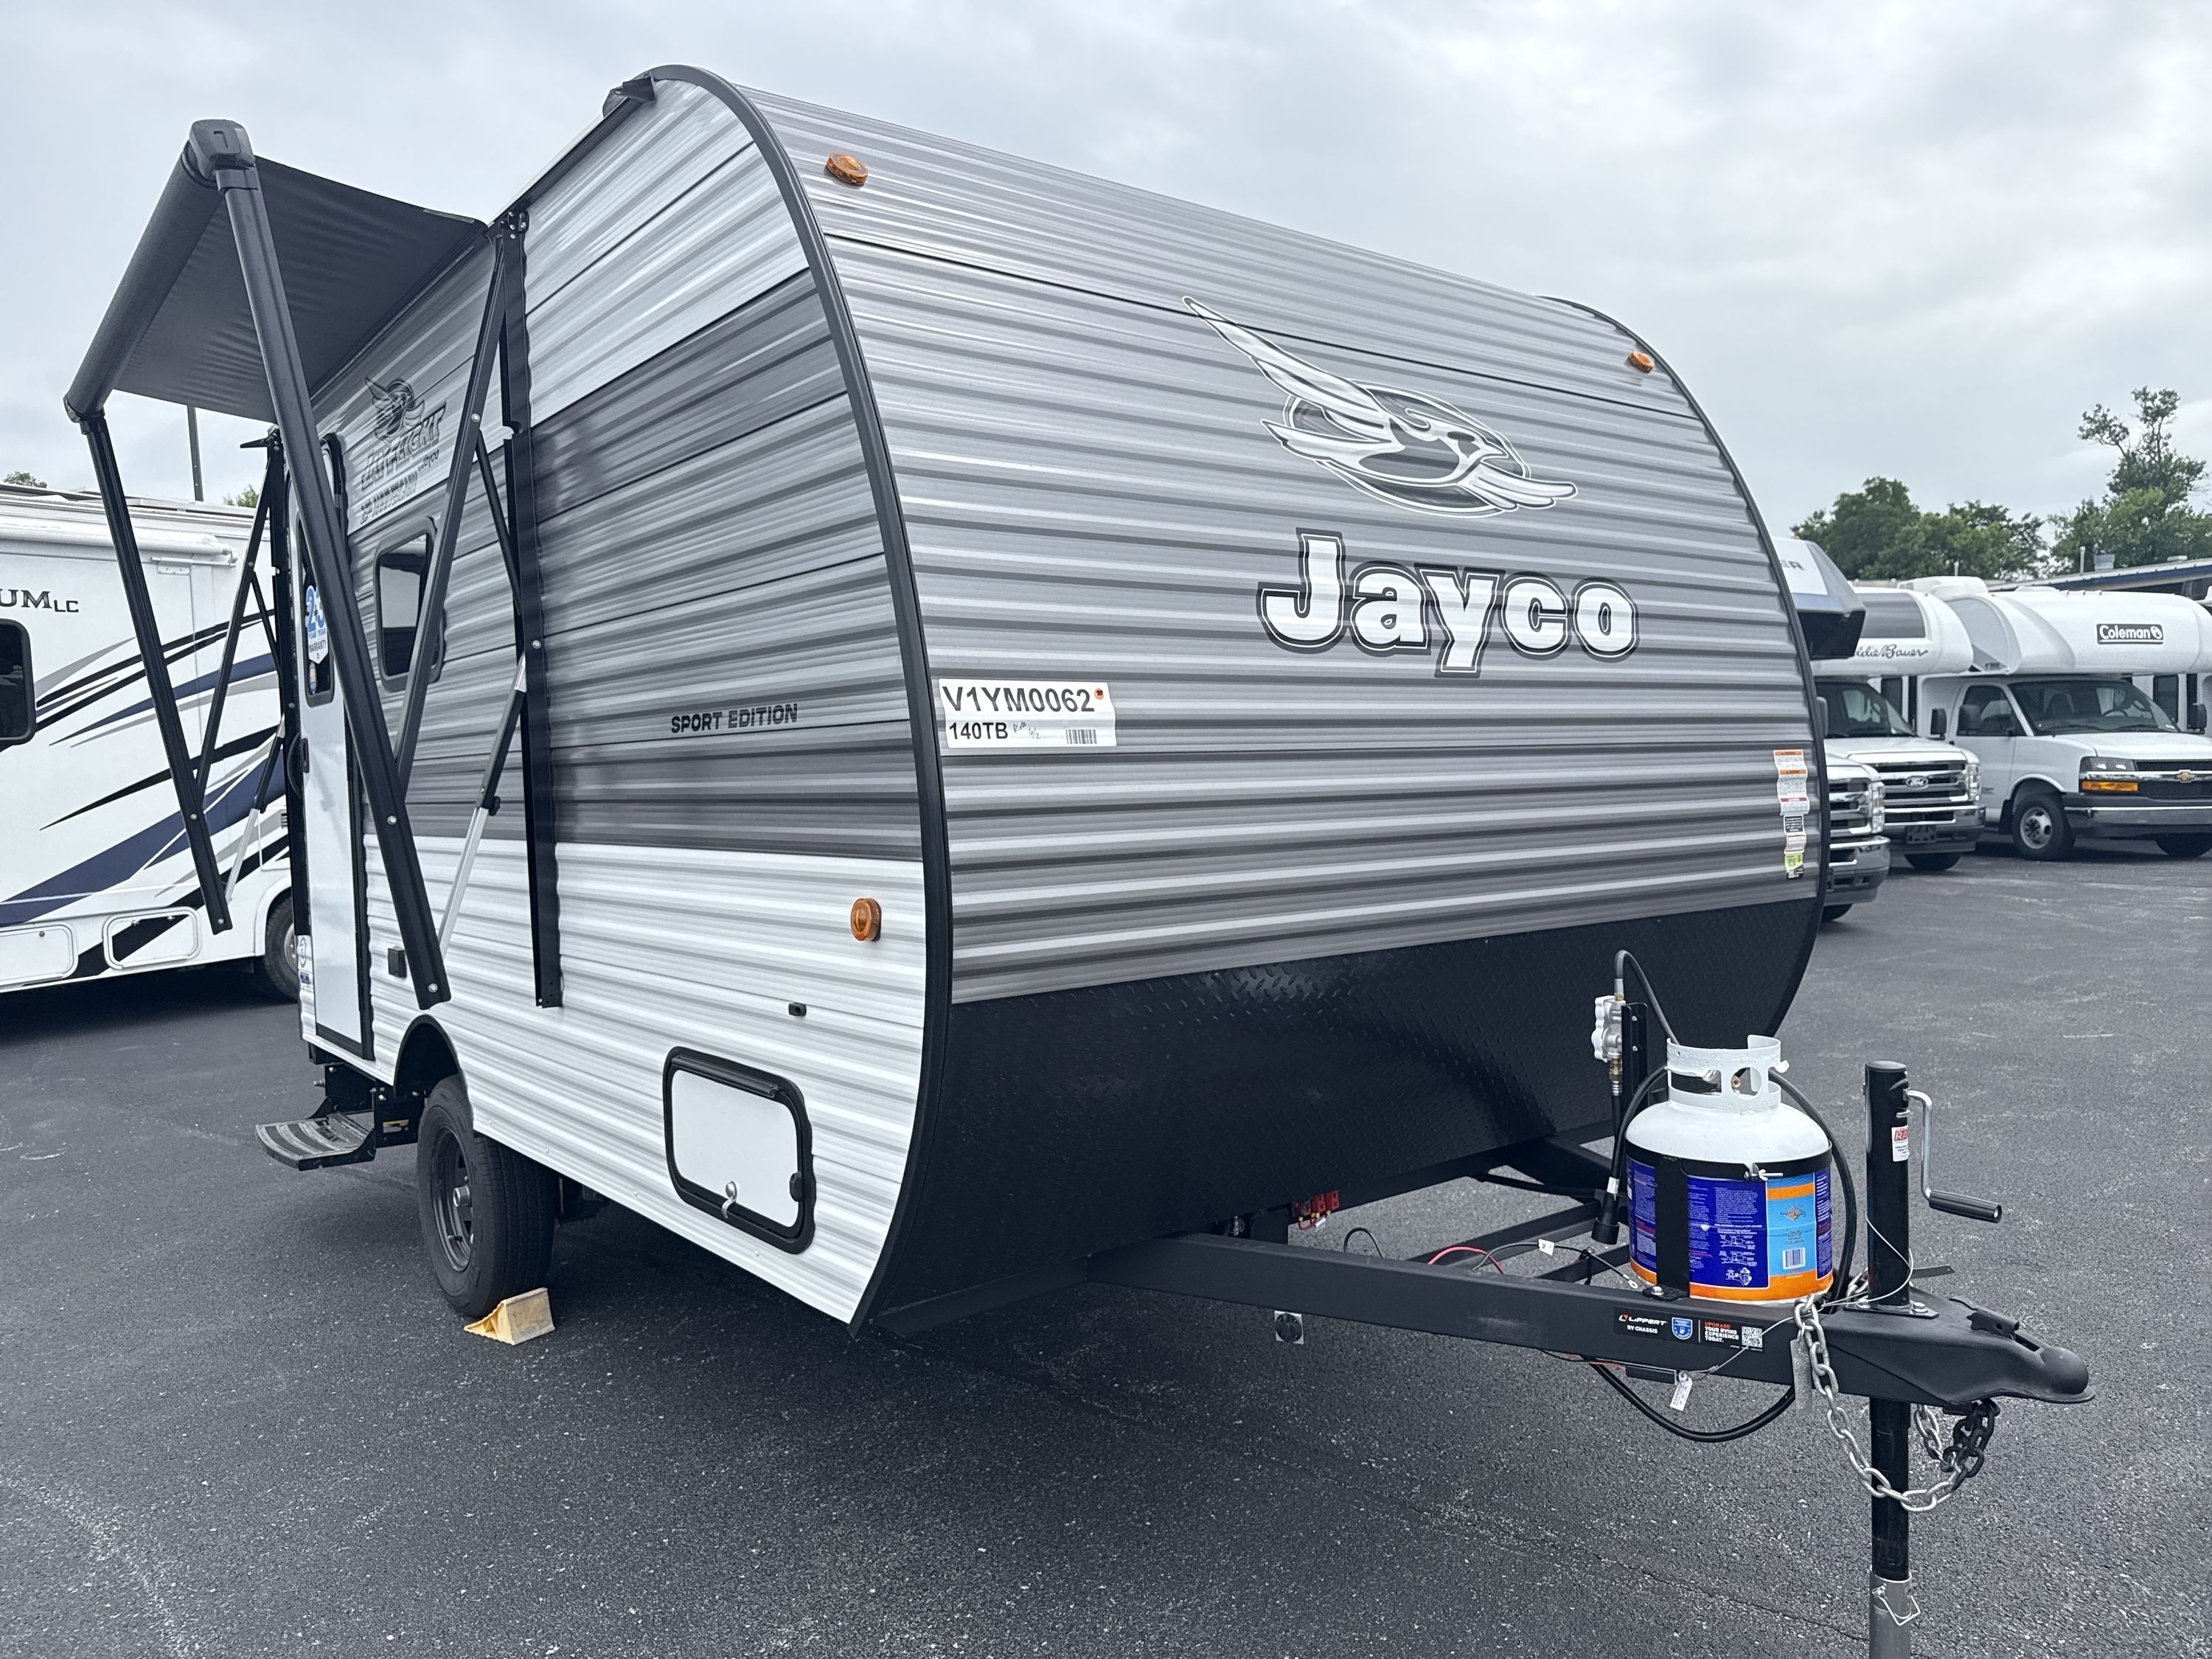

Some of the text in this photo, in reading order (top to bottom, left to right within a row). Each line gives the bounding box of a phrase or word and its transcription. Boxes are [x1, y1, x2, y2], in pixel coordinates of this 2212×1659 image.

[54, 599, 79, 613] LC
[1256, 527, 1638, 678] Jayco
[2099, 625, 2151, 640] Coleman
[308, 639, 327, 653] WARRANTY
[1881, 644, 1928, 659] Bauer
[942, 686, 1095, 712] V1YM0062
[671, 703, 798, 734] SPORT EDITION
[949, 722, 1009, 740] 140TB
[1628, 1316, 1668, 1326] LIPPERT
[1635, 1324, 1658, 1334] CHASSIS
[1704, 1331, 1739, 1340] EXPERIENCE
[1704, 1335, 1724, 1343] TODAY.
